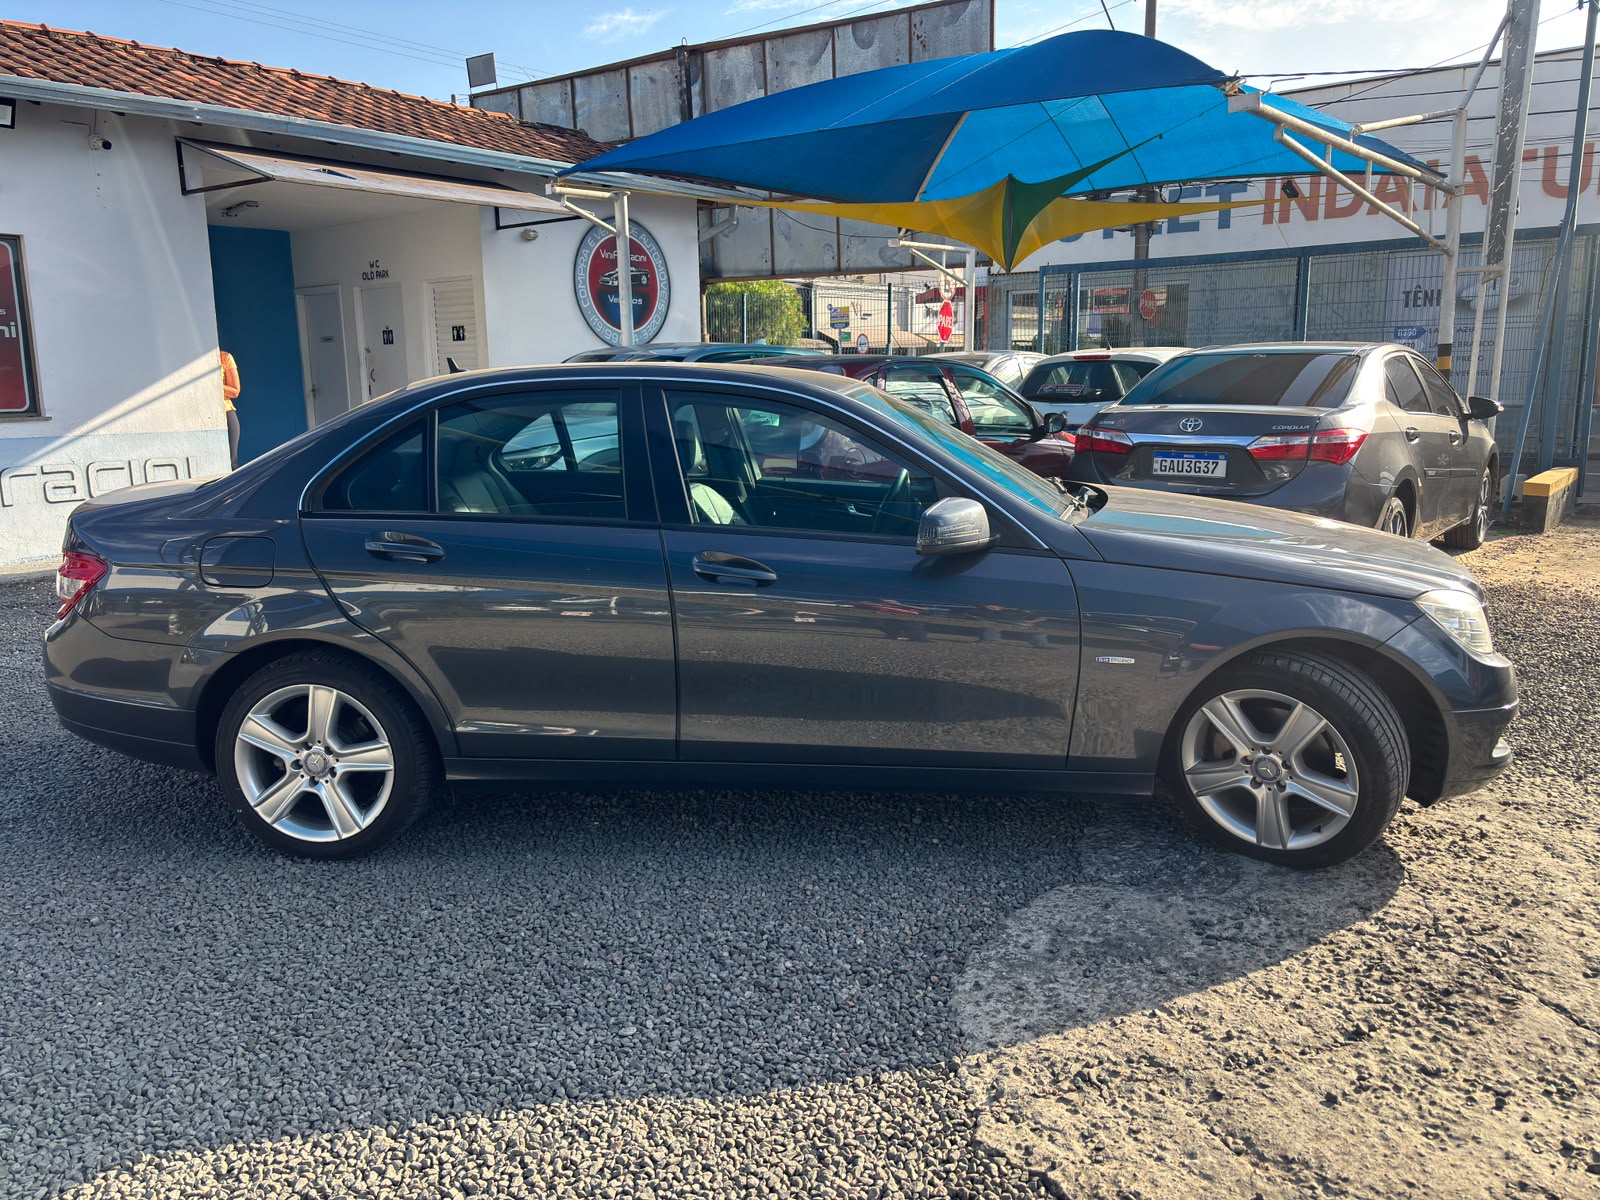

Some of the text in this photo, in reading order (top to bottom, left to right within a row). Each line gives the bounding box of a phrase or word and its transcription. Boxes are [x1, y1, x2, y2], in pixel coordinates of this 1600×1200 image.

[1262, 142, 1600, 225] INDAIAU
[362, 269, 389, 281] OLD PARK
[577, 249, 590, 308] COMPRA
[1402, 284, 1441, 308] TÊNI
[939, 314, 953, 328] PARE
[1160, 459, 1219, 475] GAU3G37
